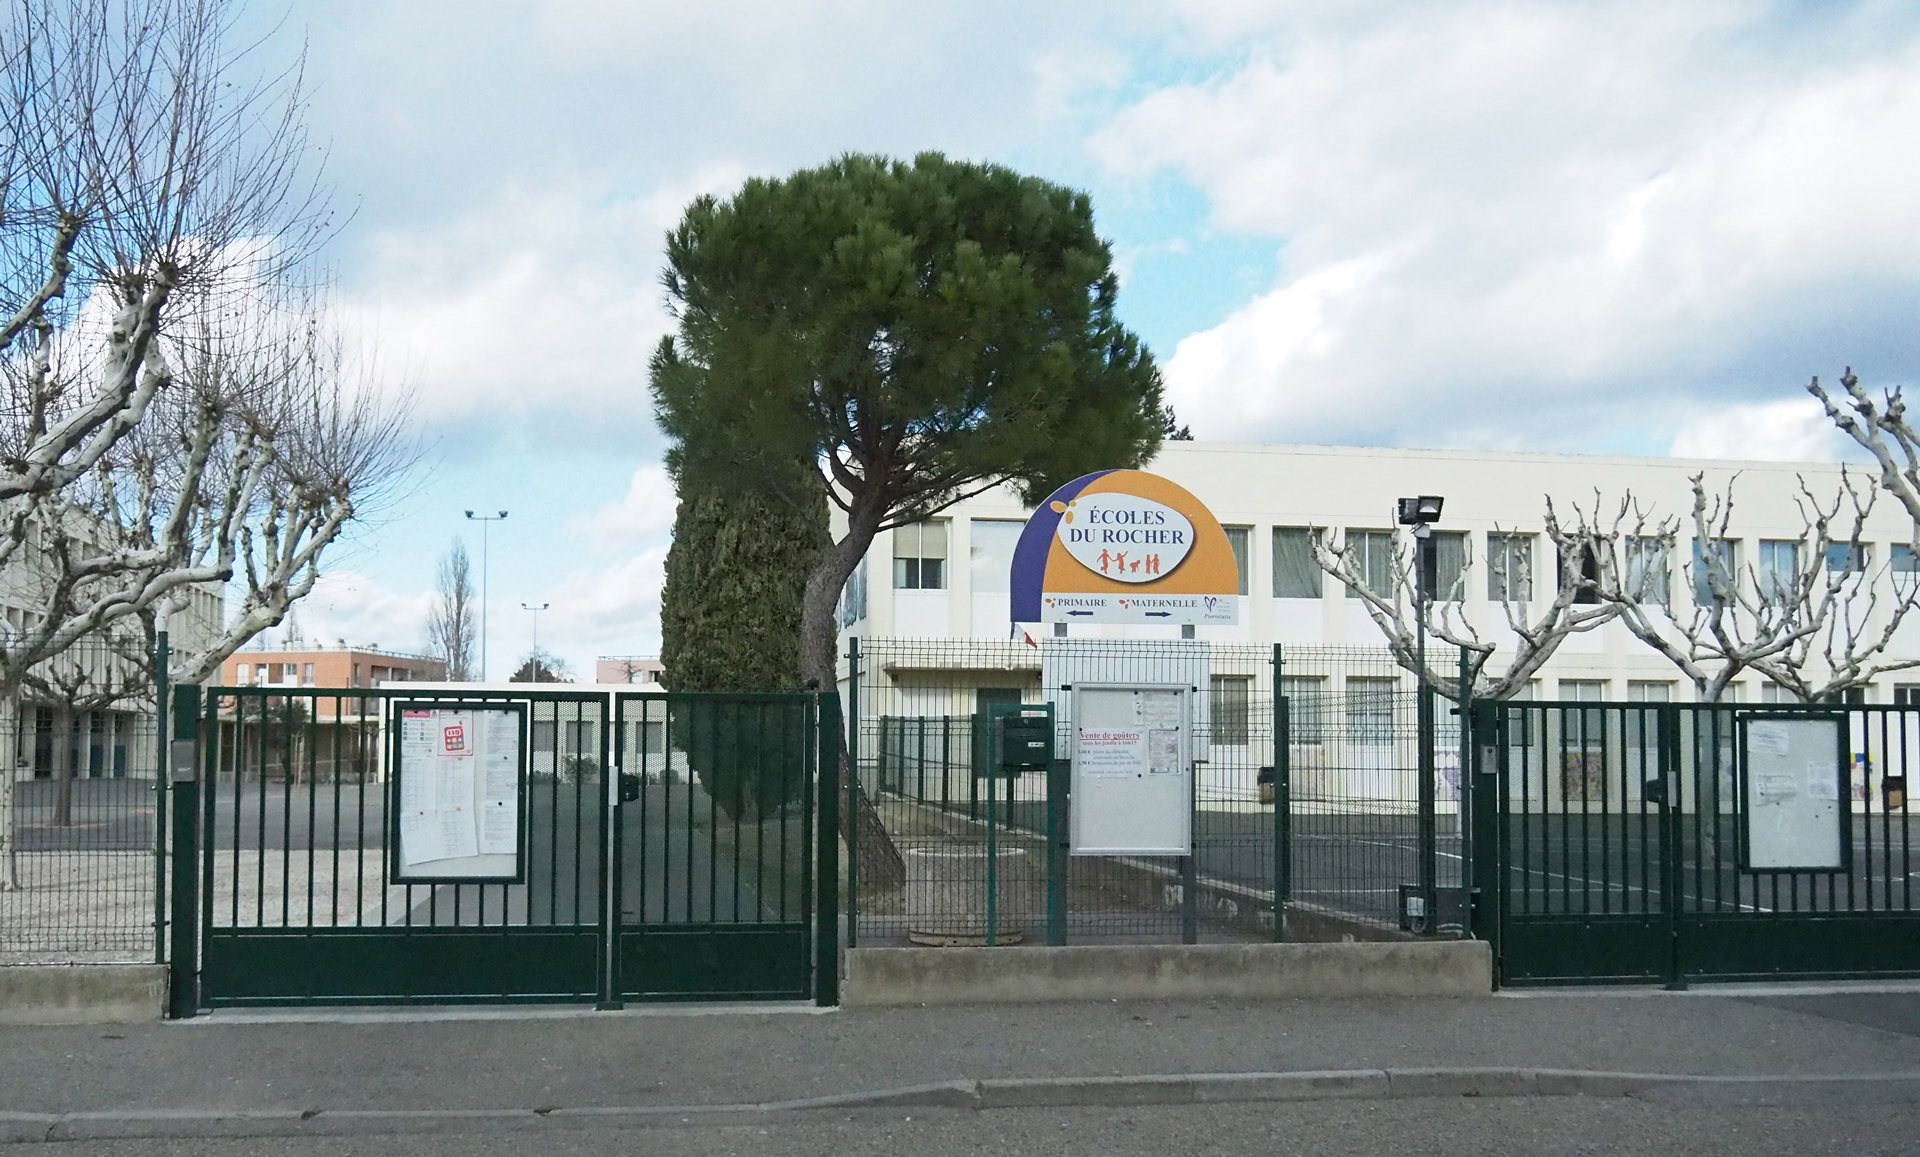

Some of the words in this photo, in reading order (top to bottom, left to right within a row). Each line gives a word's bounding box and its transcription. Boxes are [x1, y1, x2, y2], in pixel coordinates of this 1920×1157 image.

[1089, 505, 1165, 525] ÉCOLES
[1070, 528, 1096, 543] DU
[1102, 529, 1184, 545] ROCHER
[1058, 598, 1107, 607] PRIMAIRE
[1131, 599, 1198, 608] MATERNELLE
[1102, 731, 1111, 739] de
[1112, 731, 1140, 740] goûters
